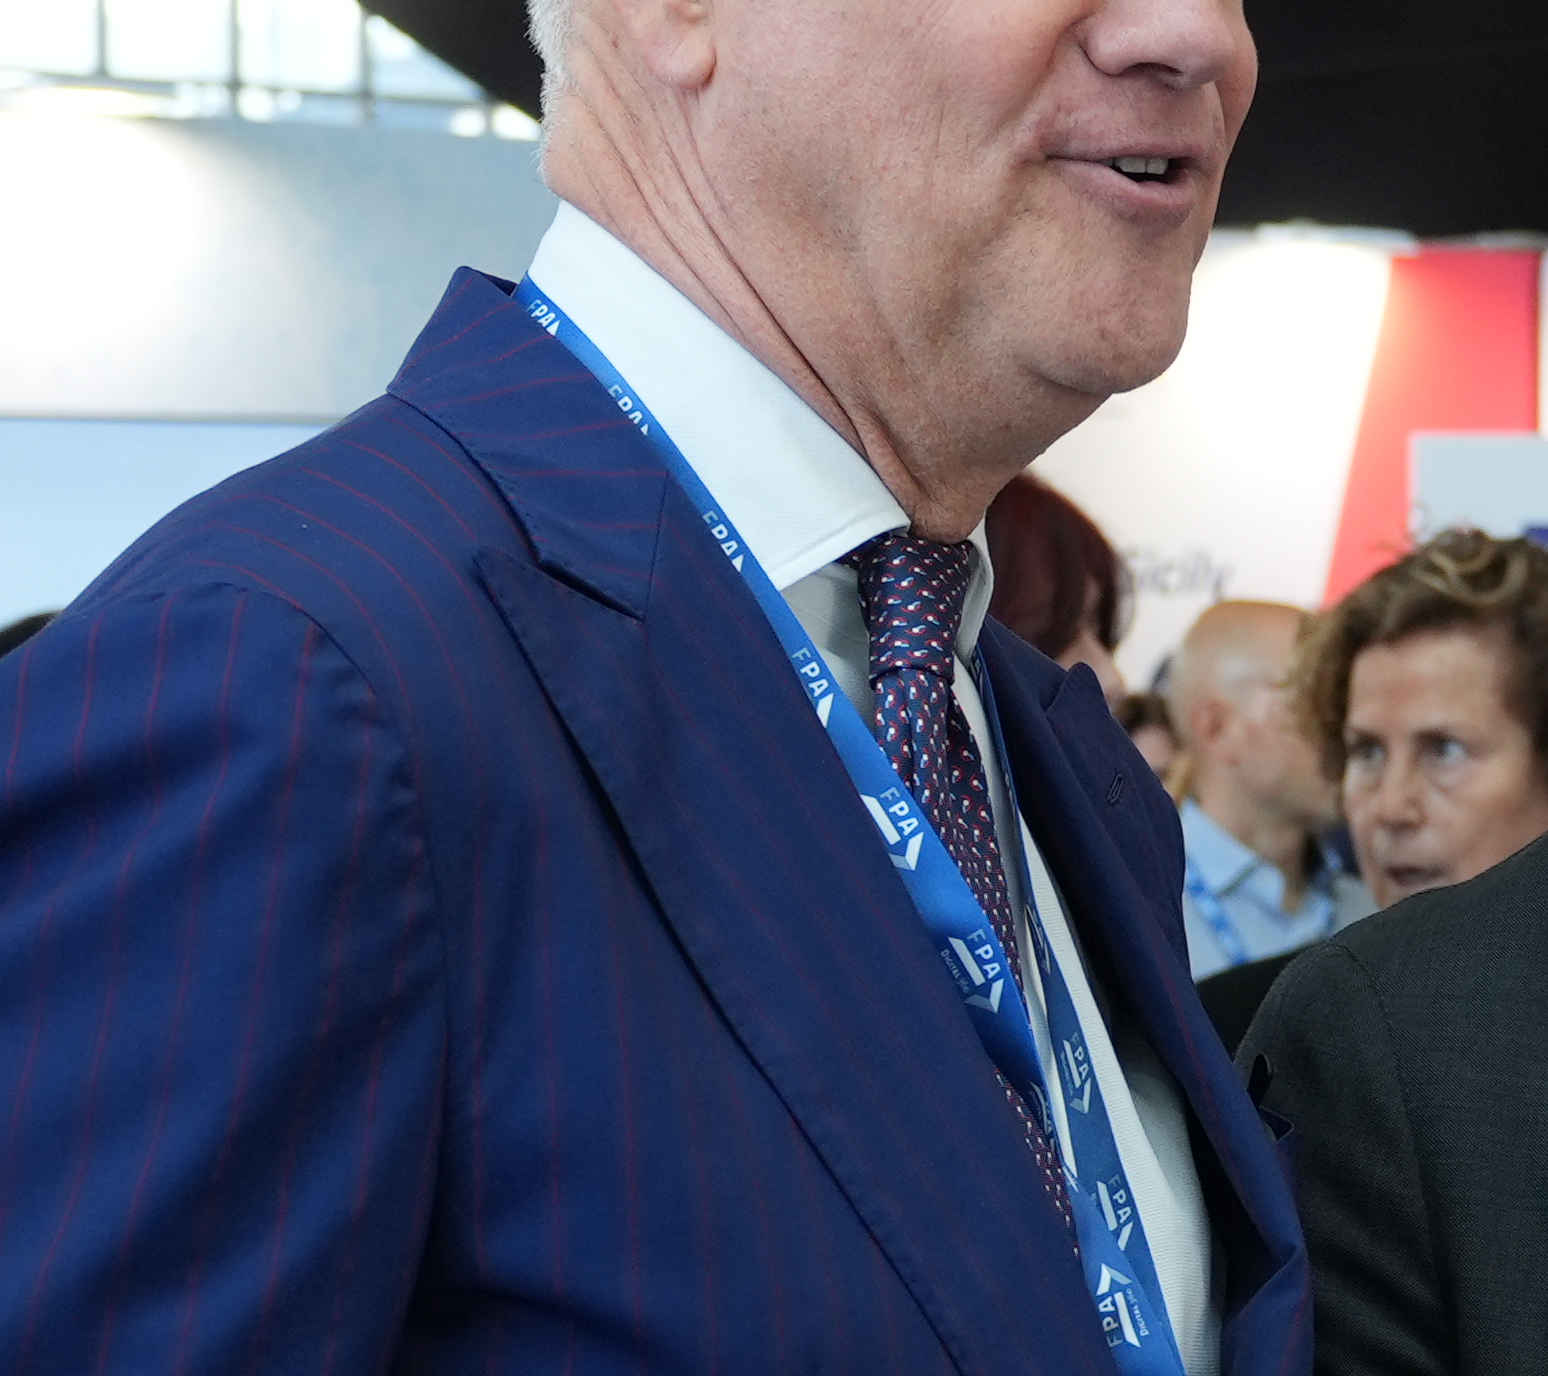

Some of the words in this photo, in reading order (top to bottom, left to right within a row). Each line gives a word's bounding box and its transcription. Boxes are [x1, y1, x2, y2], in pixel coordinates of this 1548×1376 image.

[791, 648, 829, 697] FPA
[880, 786, 919, 837] FPA
[967, 928, 1002, 980] FPA
[1108, 1174, 1132, 1224] FPA
[1099, 1295, 1123, 1348] FPA
